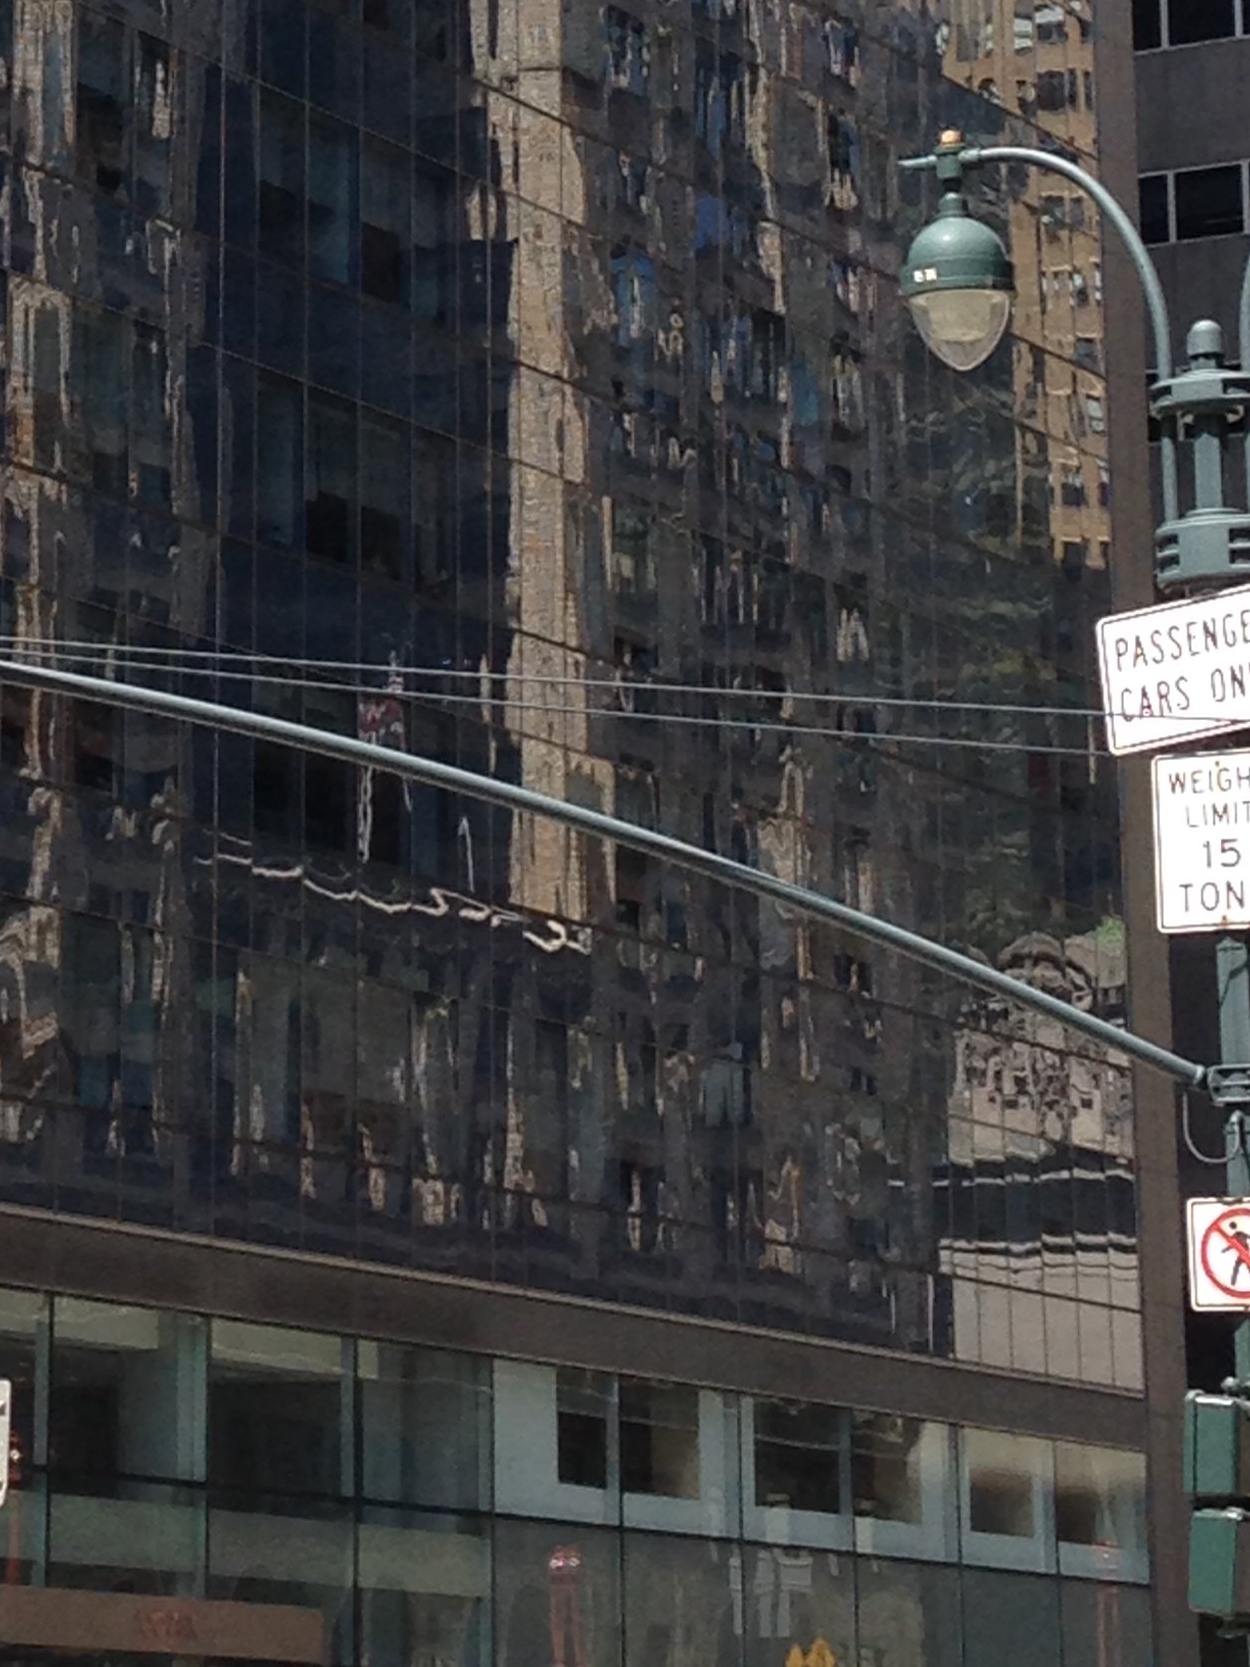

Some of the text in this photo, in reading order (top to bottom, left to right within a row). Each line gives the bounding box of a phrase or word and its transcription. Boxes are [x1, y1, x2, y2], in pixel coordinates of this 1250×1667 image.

[1115, 609, 1250, 672] PASSENGE
[1121, 663, 1250, 722] CARS ON
[1168, 766, 1250, 794] WEIGH
[1185, 800, 1250, 828] LIMIT
[1203, 839, 1241, 869] 15
[1179, 880, 1245, 913] TON
